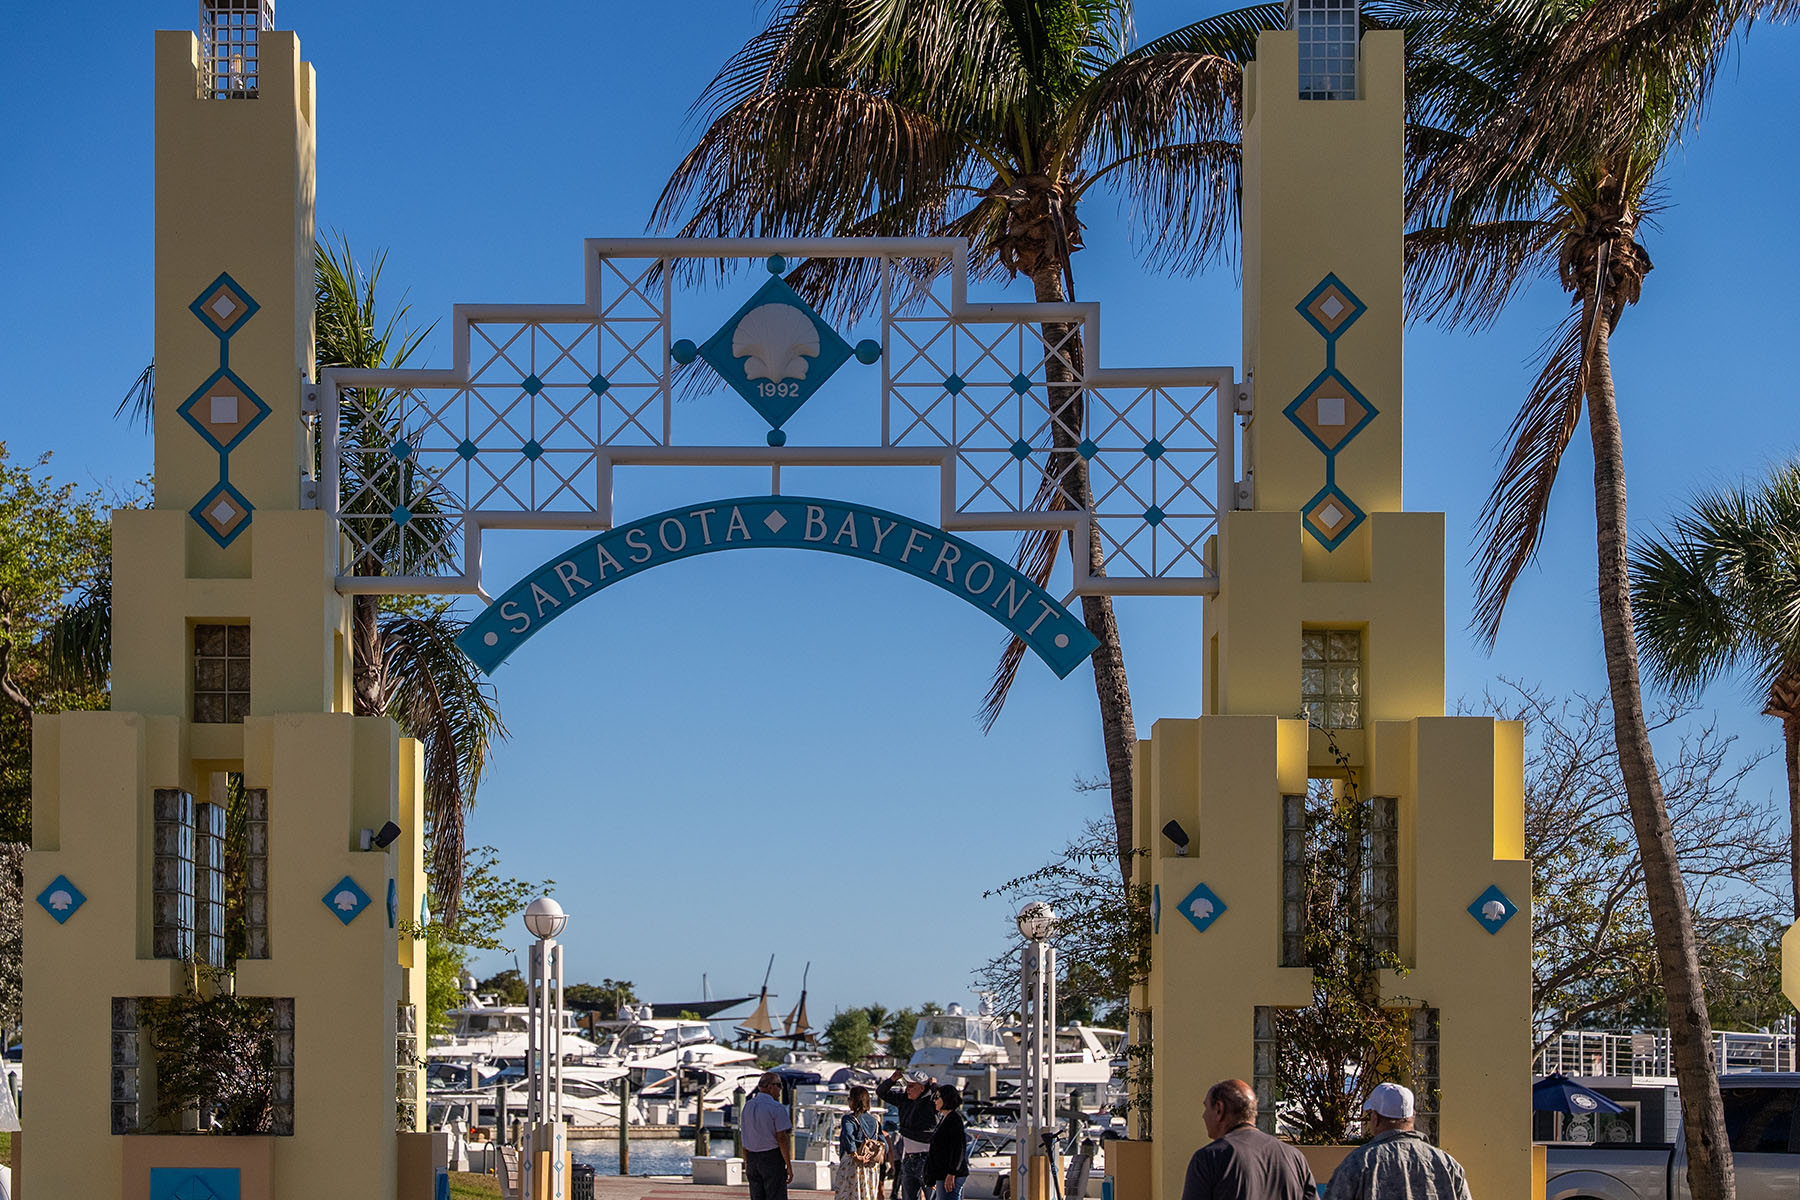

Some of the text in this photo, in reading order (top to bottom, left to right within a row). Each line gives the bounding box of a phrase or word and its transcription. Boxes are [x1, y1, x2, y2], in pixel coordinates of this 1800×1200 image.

[757, 382, 800, 398] 1992
[500, 505, 1061, 636] SARASOTA BAYFRONT
